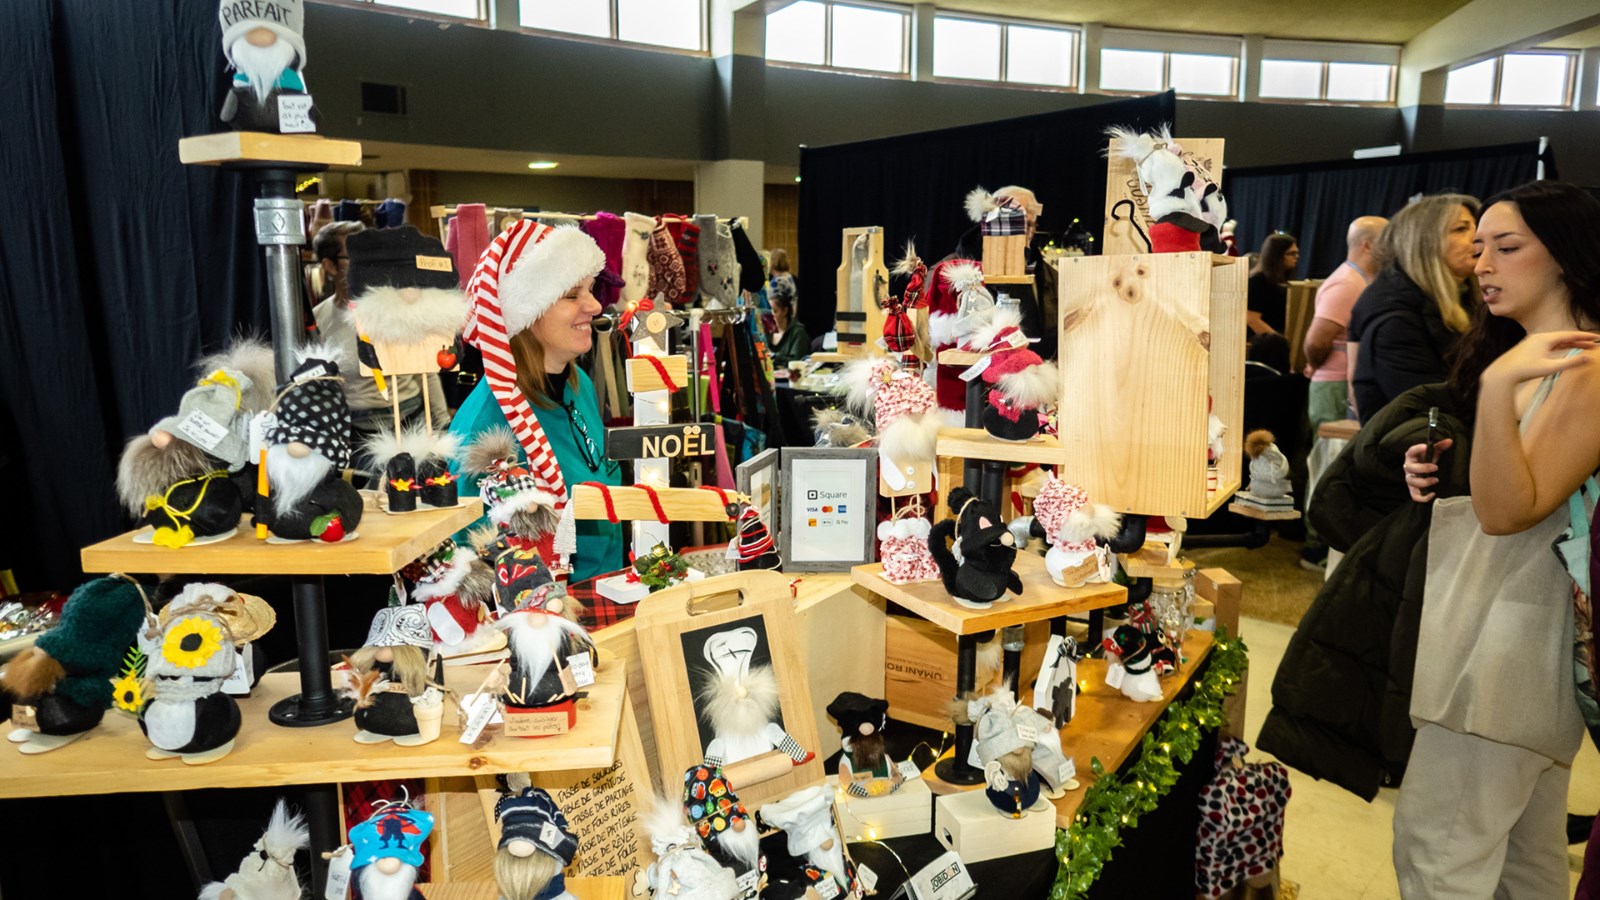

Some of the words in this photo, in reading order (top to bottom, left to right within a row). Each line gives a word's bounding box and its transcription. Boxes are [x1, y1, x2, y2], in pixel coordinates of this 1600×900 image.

[222, 0, 292, 26] PARFAIT
[642, 425, 715, 459] NOËL
[820, 491, 847, 500] Square
[905, 666, 943, 681] UMANI
[557, 783, 579, 803] TASSE
[581, 778, 591, 789] DE
[592, 759, 622, 784] SOURIRES
[581, 793, 592, 806] DE
[592, 771, 626, 797] GRATITUDE
[572, 807, 594, 825] TASSE
[595, 800, 605, 813] DE
[605, 783, 634, 806] PARTAGE
[581, 824, 591, 837] DE
[591, 813, 610, 832] FOUS
[610, 800, 631, 818] RIRES
[576, 852, 598, 873] TASSE
[600, 844, 611, 857] DE
[612, 829, 634, 850] RÊVES
[578, 836, 597, 857] TASSE
[596, 831, 606, 844] DE
[605, 855, 616, 871] DE
[617, 840, 638, 862] FOLIE
[607, 856, 640, 877] 'AMOUR
